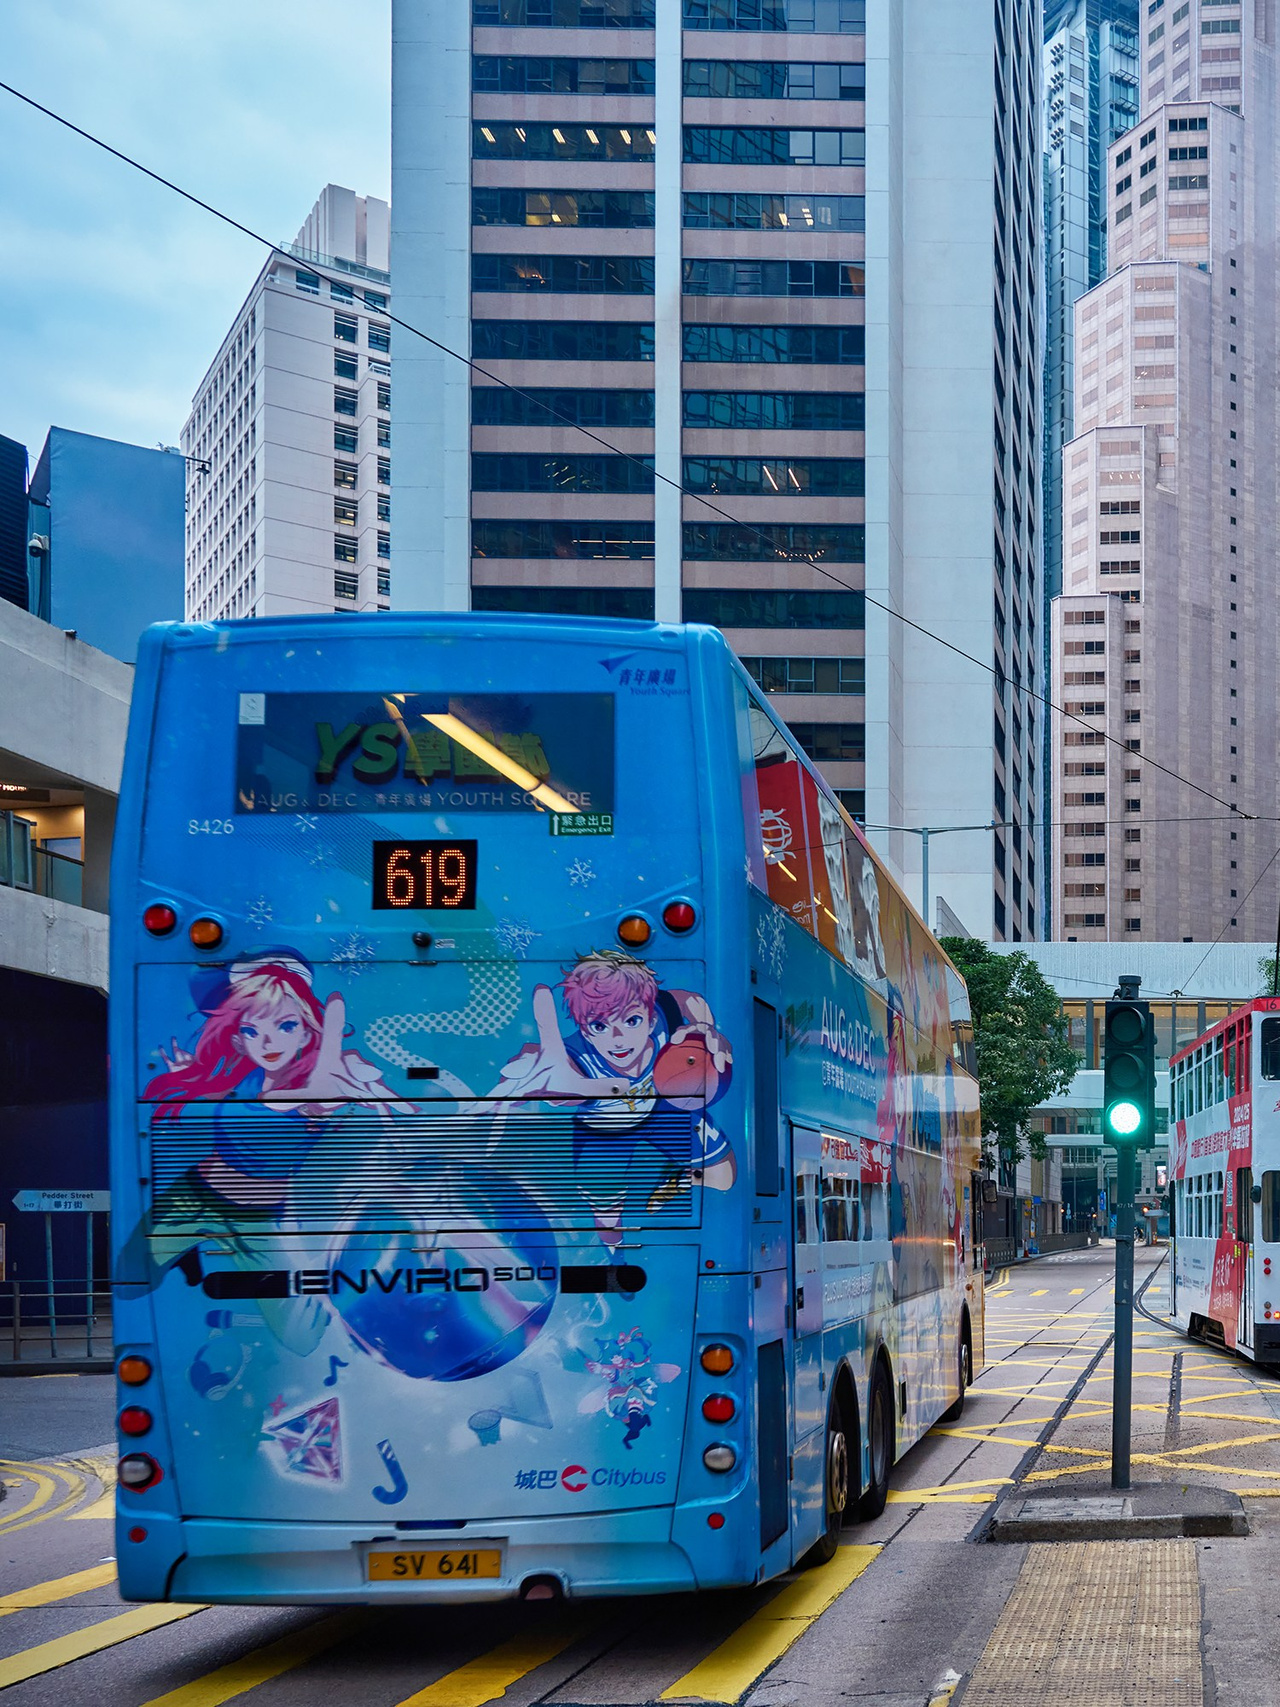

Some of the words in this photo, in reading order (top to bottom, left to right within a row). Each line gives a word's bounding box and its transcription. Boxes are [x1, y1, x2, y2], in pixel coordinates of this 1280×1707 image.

[619, 669, 677, 686] 青年廣場
[630, 687, 658, 696] Youth
[660, 688, 691, 698] Square
[318, 793, 358, 807] DEC
[437, 792, 504, 806] YOUTH
[188, 819, 234, 836] 8426
[561, 815, 612, 826] 緊急出口
[386, 849, 466, 905] 619
[1266, 1000, 1277, 1010] 16
[294, 1266, 489, 1296] ENVIRO
[493, 1266, 557, 1282] 500
[515, 1469, 557, 1490] 城巴
[591, 1467, 667, 1488] Citybus
[392, 1555, 424, 1576] SV
[437, 1555, 478, 1576] 641
